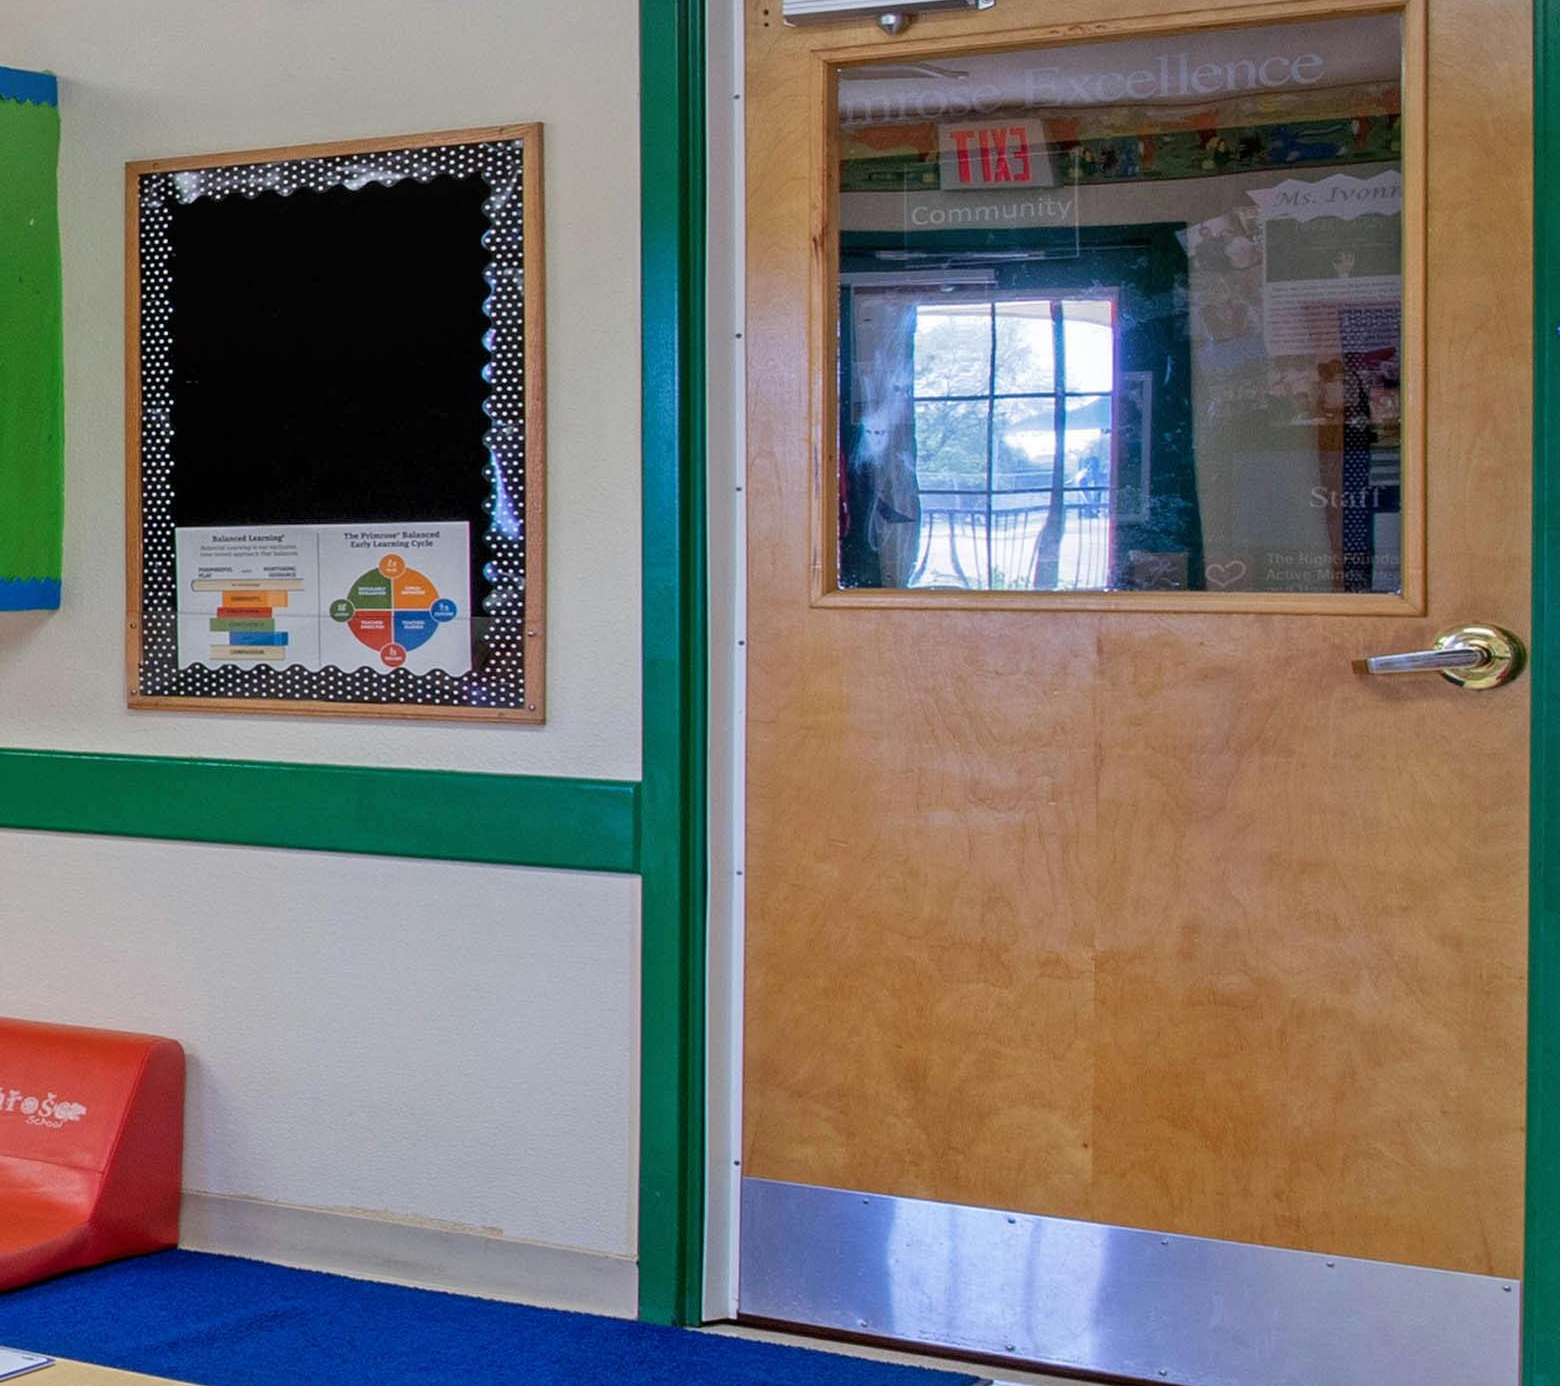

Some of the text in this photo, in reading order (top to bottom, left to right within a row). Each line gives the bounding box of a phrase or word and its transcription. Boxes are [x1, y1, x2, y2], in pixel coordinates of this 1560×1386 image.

[1022, 50, 1325, 108] Excellence
[1275, 190, 1317, 207] Ms.
[911, 195, 1074, 228] Community
[1310, 486, 1384, 509] Staff
[212, 534, 247, 542] Balanced
[344, 532, 358, 540] The
[402, 530, 440, 539] Balanced
[350, 539, 433, 549] Early Learning Cycle
[25, 1116, 64, 1129] School
